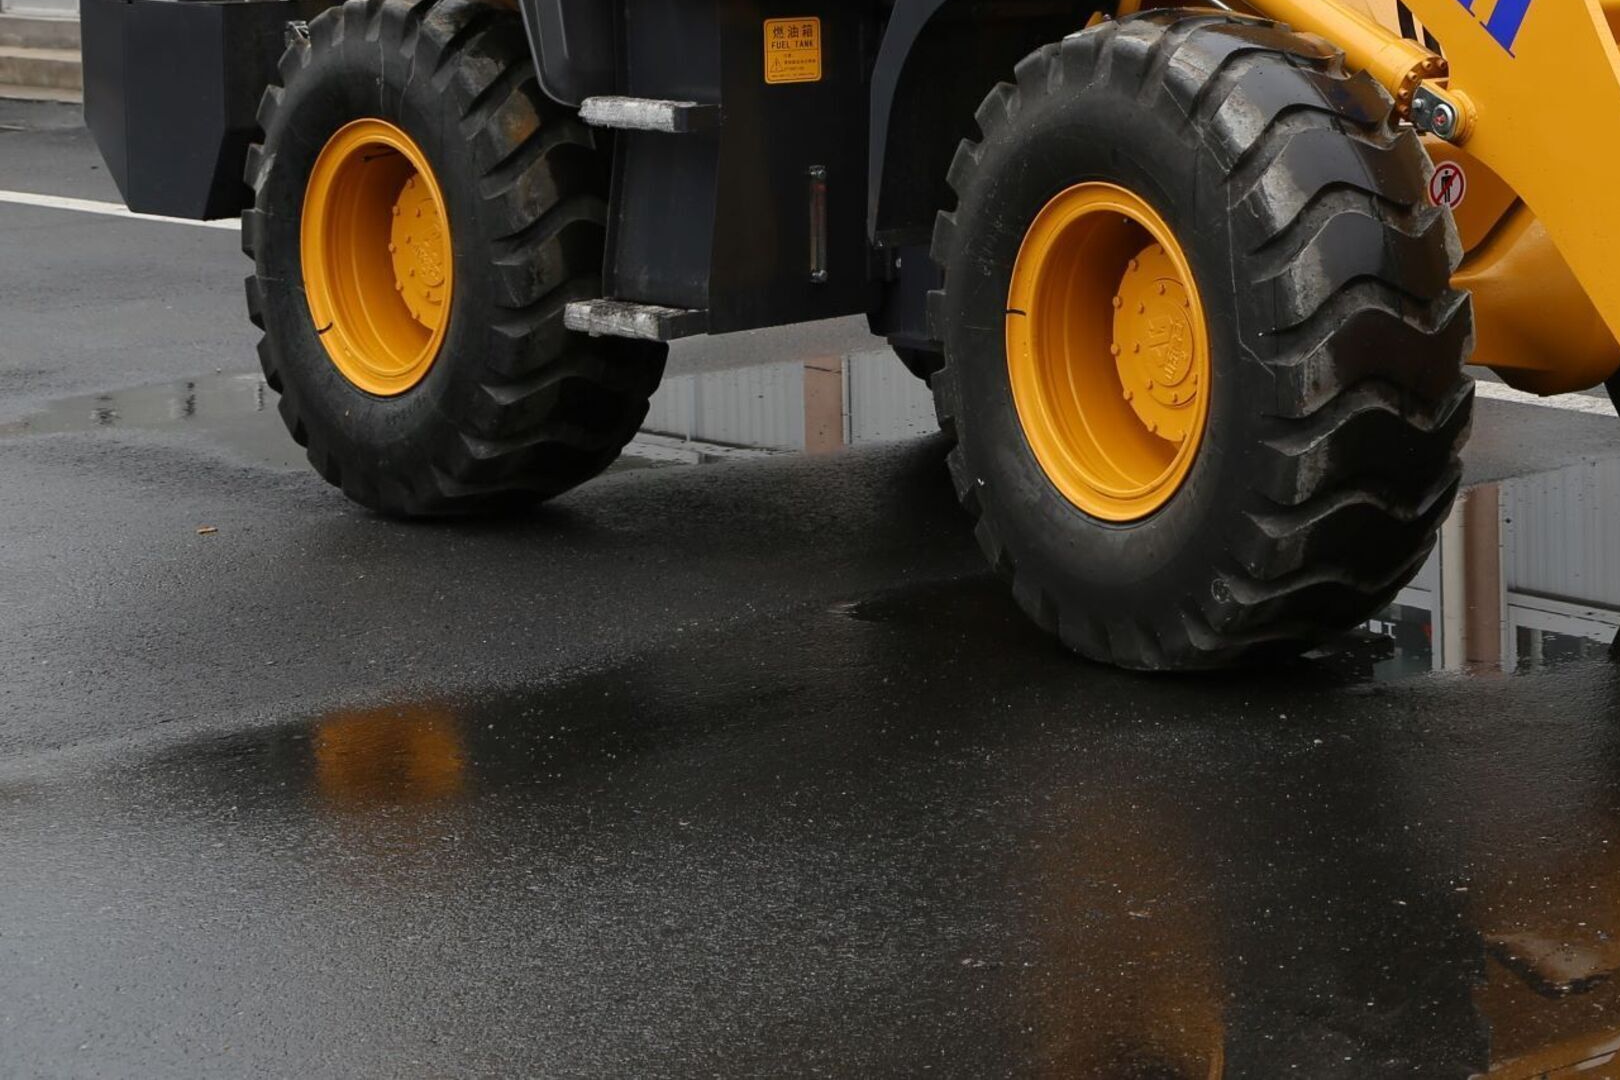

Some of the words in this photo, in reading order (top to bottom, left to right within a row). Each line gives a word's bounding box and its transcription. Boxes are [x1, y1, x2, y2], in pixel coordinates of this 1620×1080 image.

[773, 24, 813, 39] 燃油箱
[771, 40, 789, 49] FUEL
[795, 39, 813, 48] TANK
